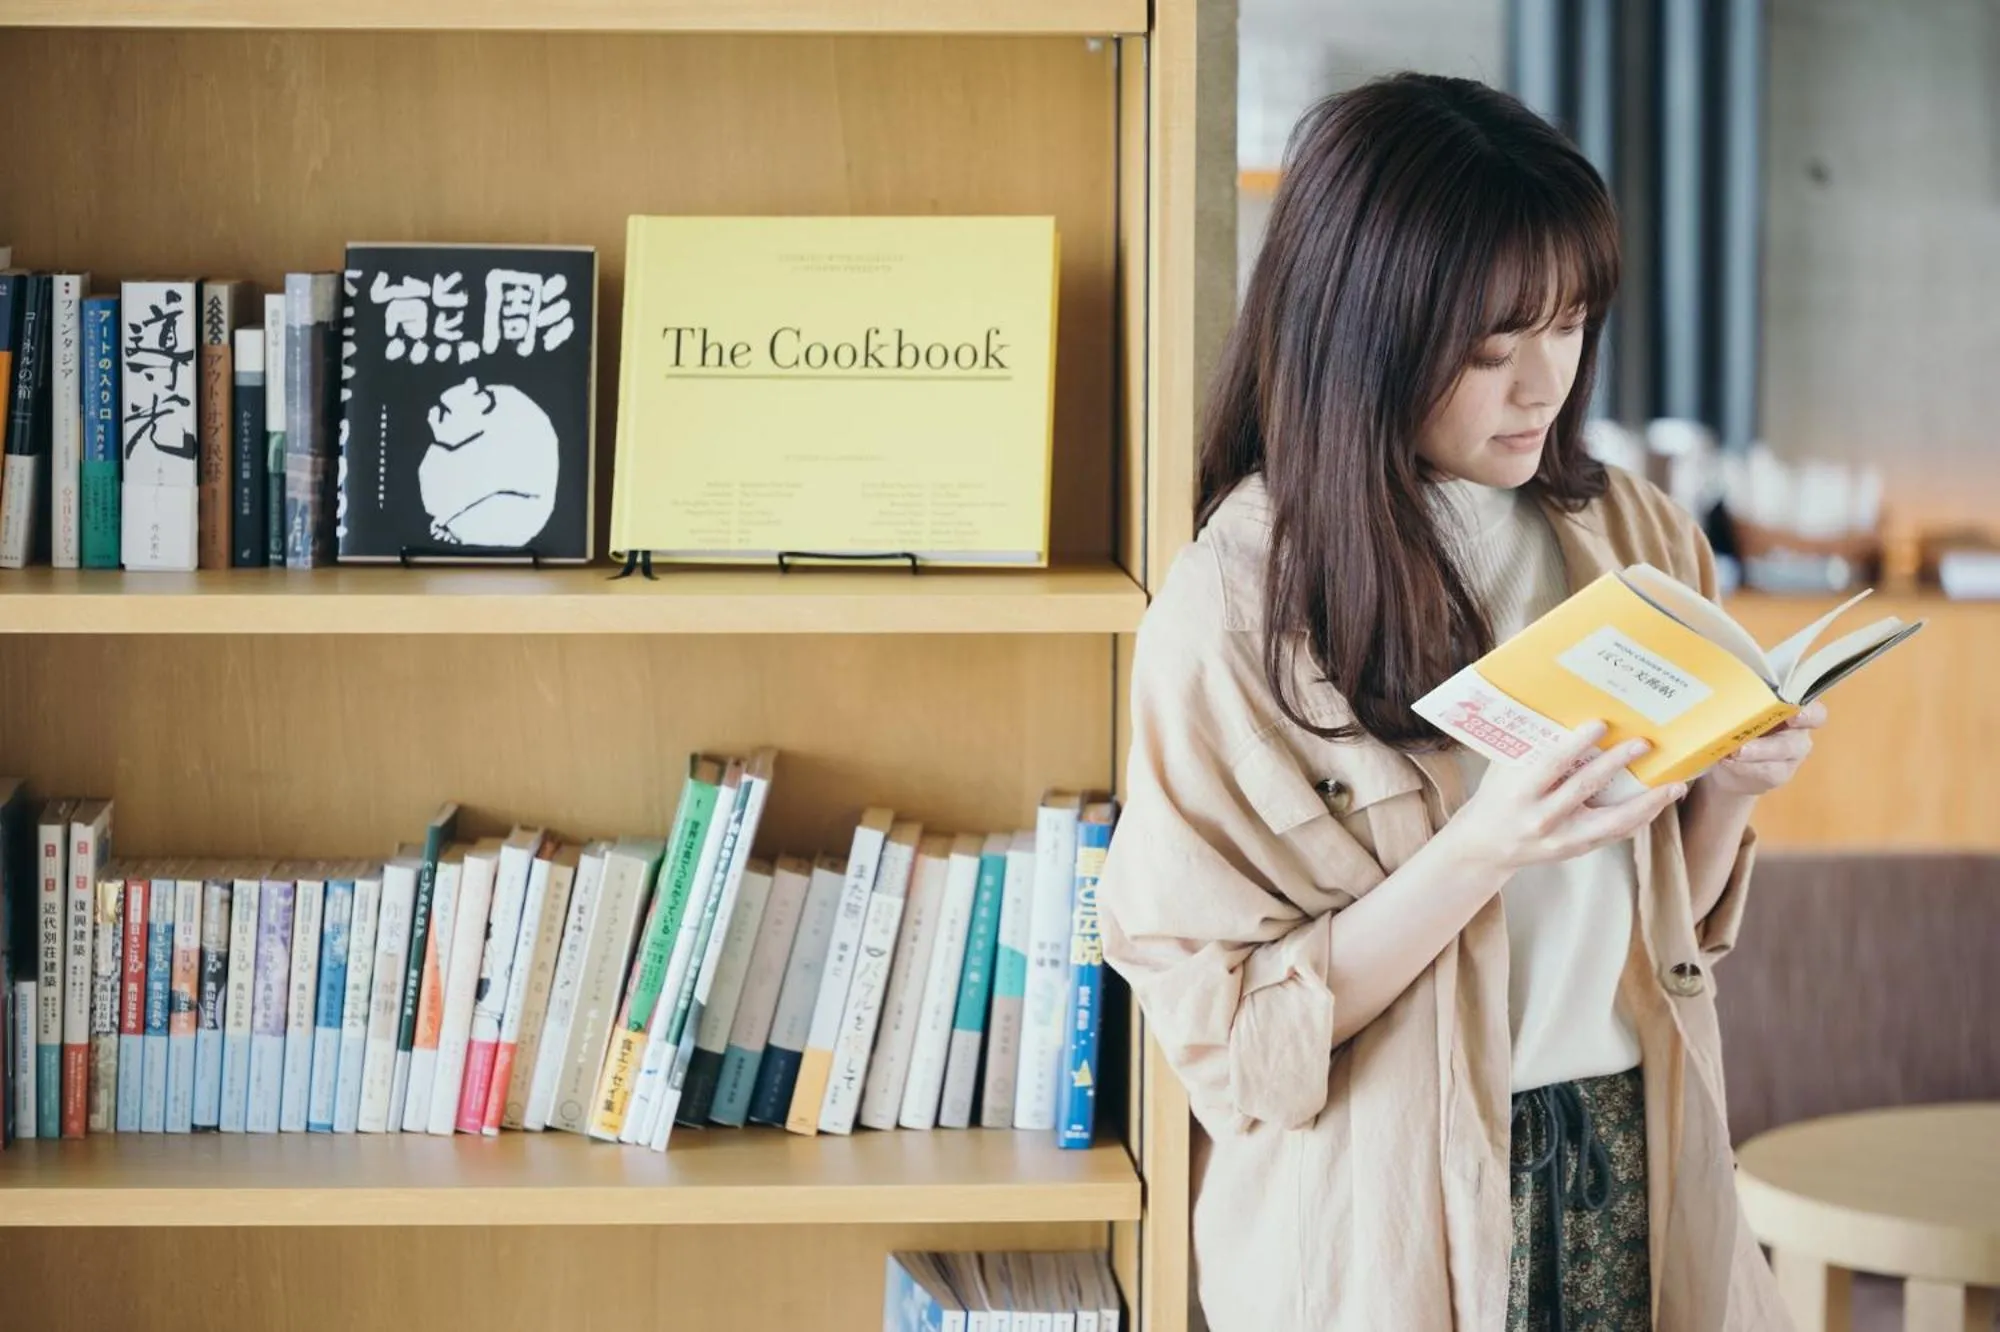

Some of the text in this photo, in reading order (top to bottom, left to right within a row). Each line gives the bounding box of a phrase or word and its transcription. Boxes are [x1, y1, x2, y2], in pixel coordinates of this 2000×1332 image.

[60, 299, 74, 379] ファンタジア
[370, 268, 574, 364] 熊彫
[662, 326, 1011, 371] The Cookbook
[98, 309, 112, 420] アートの入り口
[1470, 717, 1528, 751] OSAMU
[42, 902, 57, 988] 近代別荘建築
[73, 900, 87, 957] 復興建築
